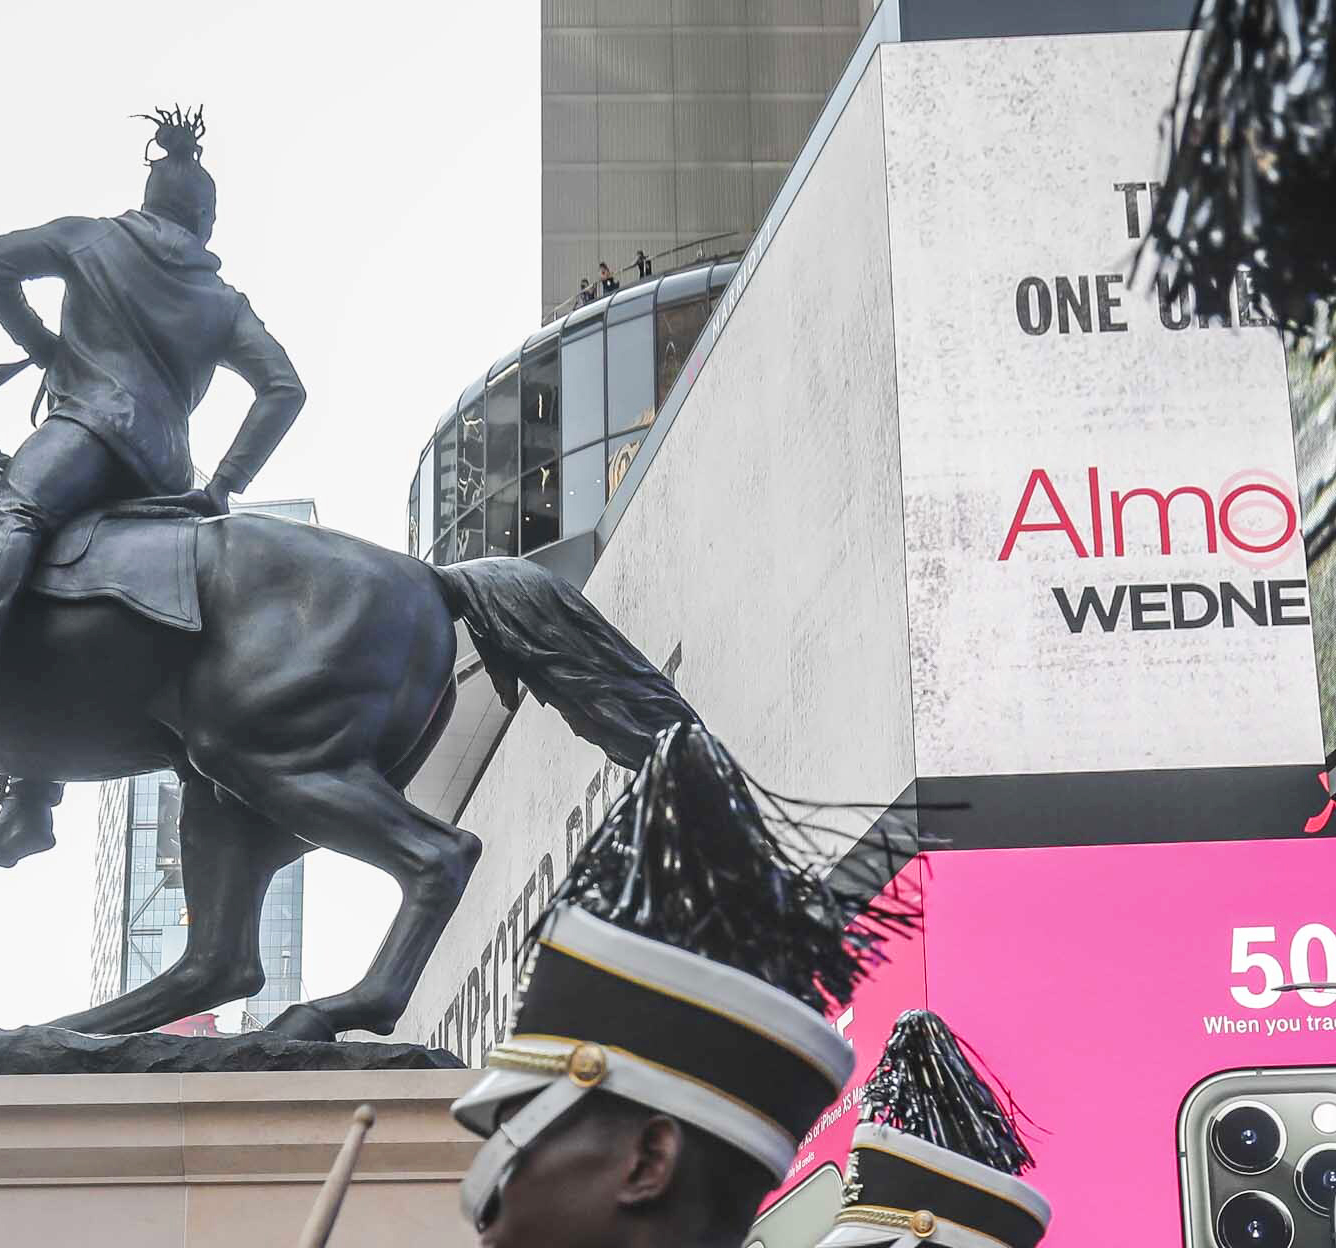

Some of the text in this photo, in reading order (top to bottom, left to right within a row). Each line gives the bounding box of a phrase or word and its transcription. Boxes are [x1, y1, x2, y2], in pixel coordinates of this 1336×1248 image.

[711, 219, 772, 341] MARRIOTT
[1016, 273, 1128, 335] ONE
[997, 466, 1297, 561] Almo
[1051, 579, 1311, 634] WEDNE
[1204, 1013, 1262, 1034] When
[1265, 1017, 1302, 1036] you
[820, 1106, 842, 1132] iPhone
[842, 1093, 852, 1114] XS
